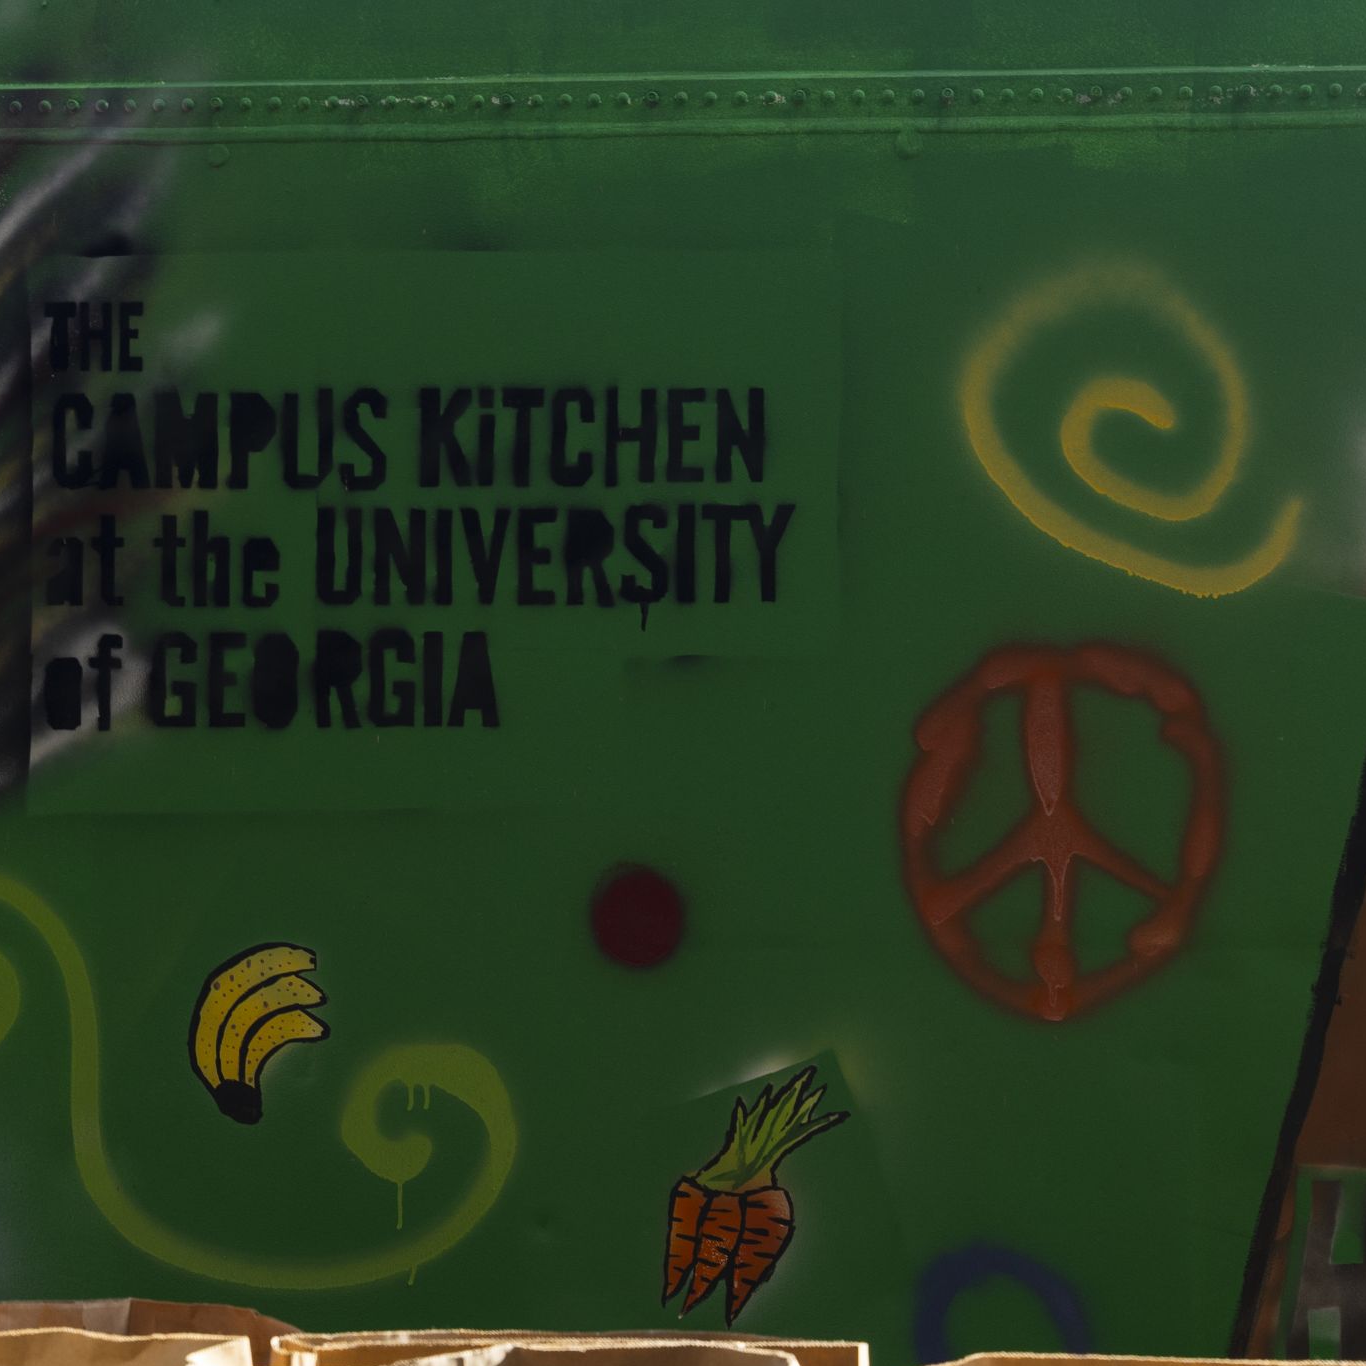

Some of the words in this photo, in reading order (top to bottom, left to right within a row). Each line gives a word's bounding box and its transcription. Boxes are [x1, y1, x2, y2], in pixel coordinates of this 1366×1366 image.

[45, 302, 144, 371] THE
[51, 388, 387, 490] CAMPUS
[46, 515, 124, 606] at
[154, 511, 280, 607] the
[316, 503, 796, 607] UNIVERSITY
[45, 634, 123, 730] of
[151, 628, 500, 729] GEORGIA
